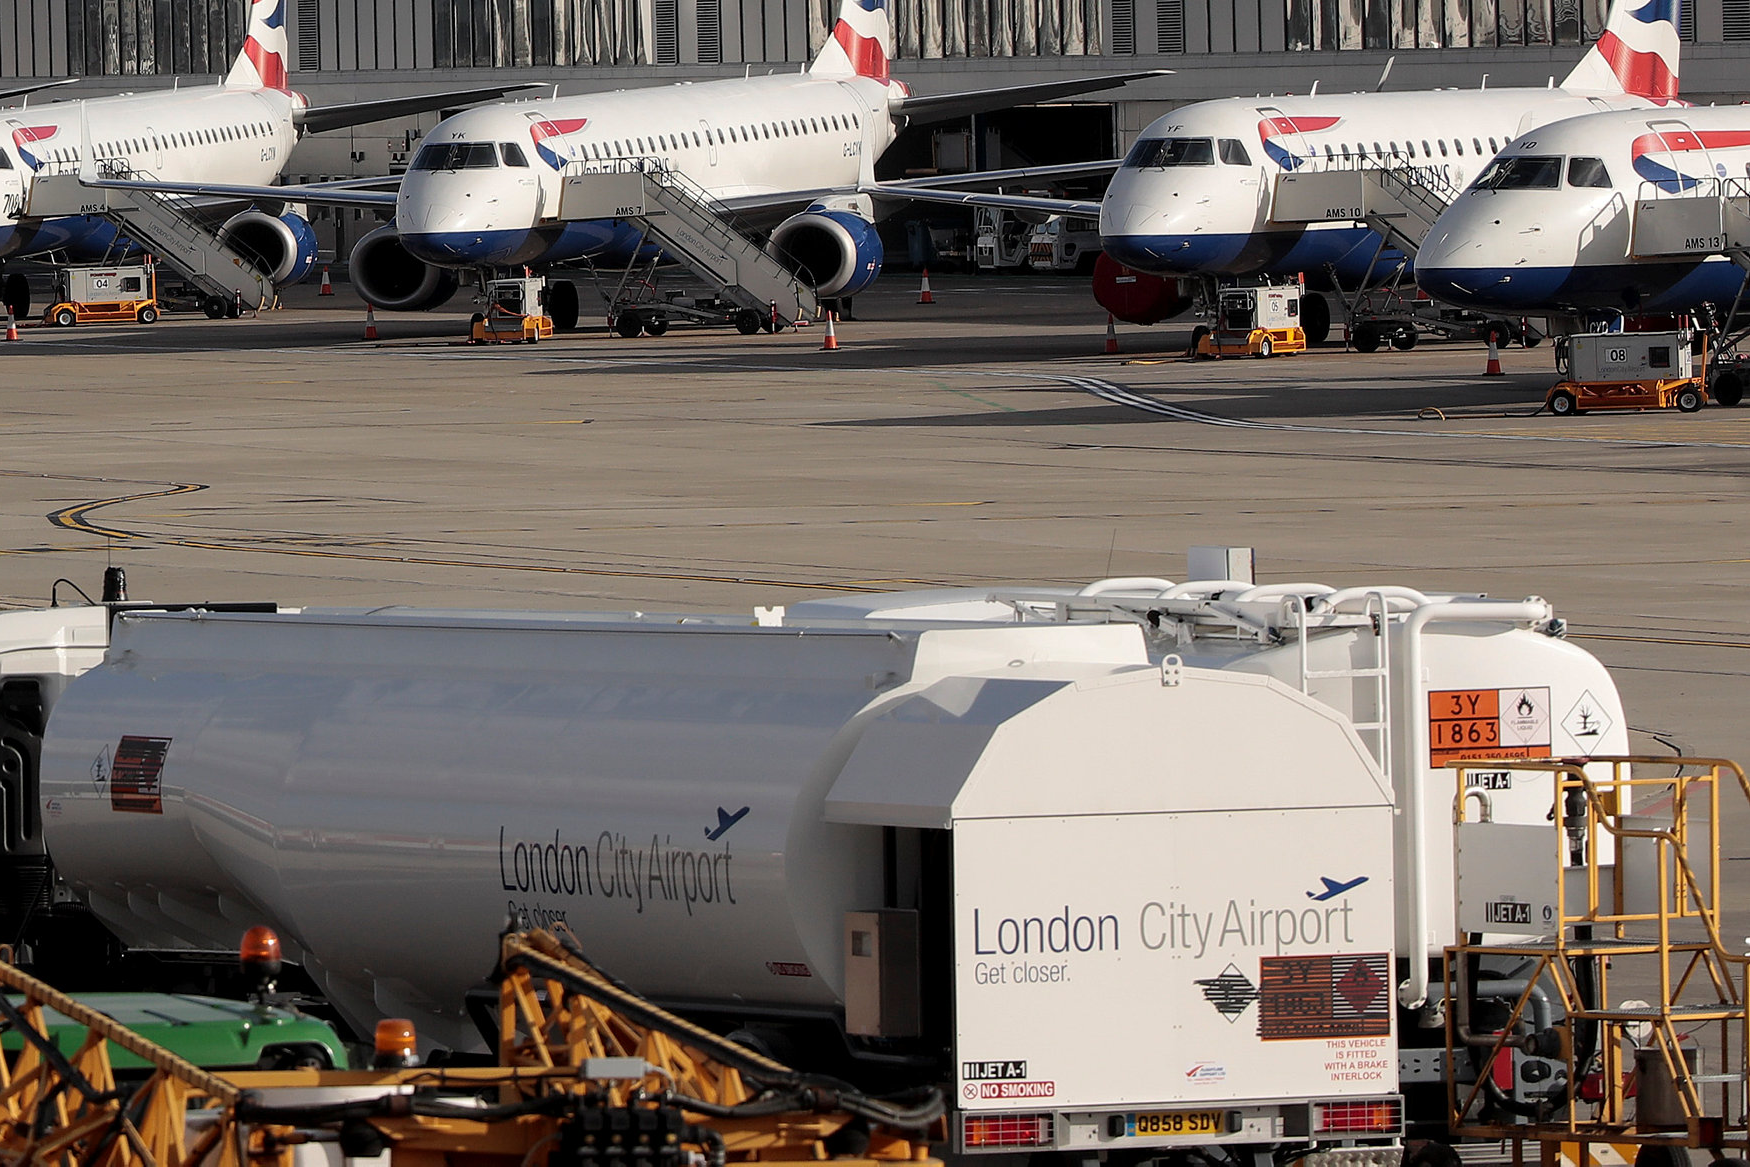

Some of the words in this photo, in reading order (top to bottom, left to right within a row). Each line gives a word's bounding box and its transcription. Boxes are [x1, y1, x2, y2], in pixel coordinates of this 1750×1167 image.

[1520, 141, 1537, 149] YD
[615, 207, 634, 216] AMS
[636, 206, 642, 214] 7
[1326, 208, 1346, 218] AMS
[1349, 207, 1361, 217] 10
[1685, 237, 1704, 249] AMS
[1708, 236, 1720, 248] 13
[96, 279, 108, 289] 04
[1271, 301, 1278, 312] 05
[1590, 321, 1609, 334] CYD
[1610, 349, 1626, 361] 08
[1450, 694, 1481, 716] 3Y
[1437, 721, 1498, 745] 1863
[500, 825, 593, 896] London
[1495, 904, 1513, 922] JET
[1514, 904, 1530, 922] A-1
[974, 905, 1119, 955] London
[974, 961, 1006, 984] Get
[1013, 960, 1071, 983] closer.
[1326, 1040, 1346, 1048] THIS
[1348, 1039, 1386, 1048] VEHICLE
[1336, 1051, 1344, 1059] IS
[1346, 1050, 1377, 1058] FITTED
[980, 1062, 1004, 1078] JET
[1005, 1062, 1026, 1078] A-1
[1324, 1061, 1347, 1070] WITH
[1349, 1061, 1355, 1069] A
[1357, 1060, 1388, 1069] BRAKE
[1331, 1071, 1382, 1081] INTERLOCK
[981, 1084, 999, 1097] NO
[1001, 1082, 1054, 1097] SMOKING
[1138, 1114, 1183, 1133] Q858
[1188, 1112, 1221, 1131] SDV
